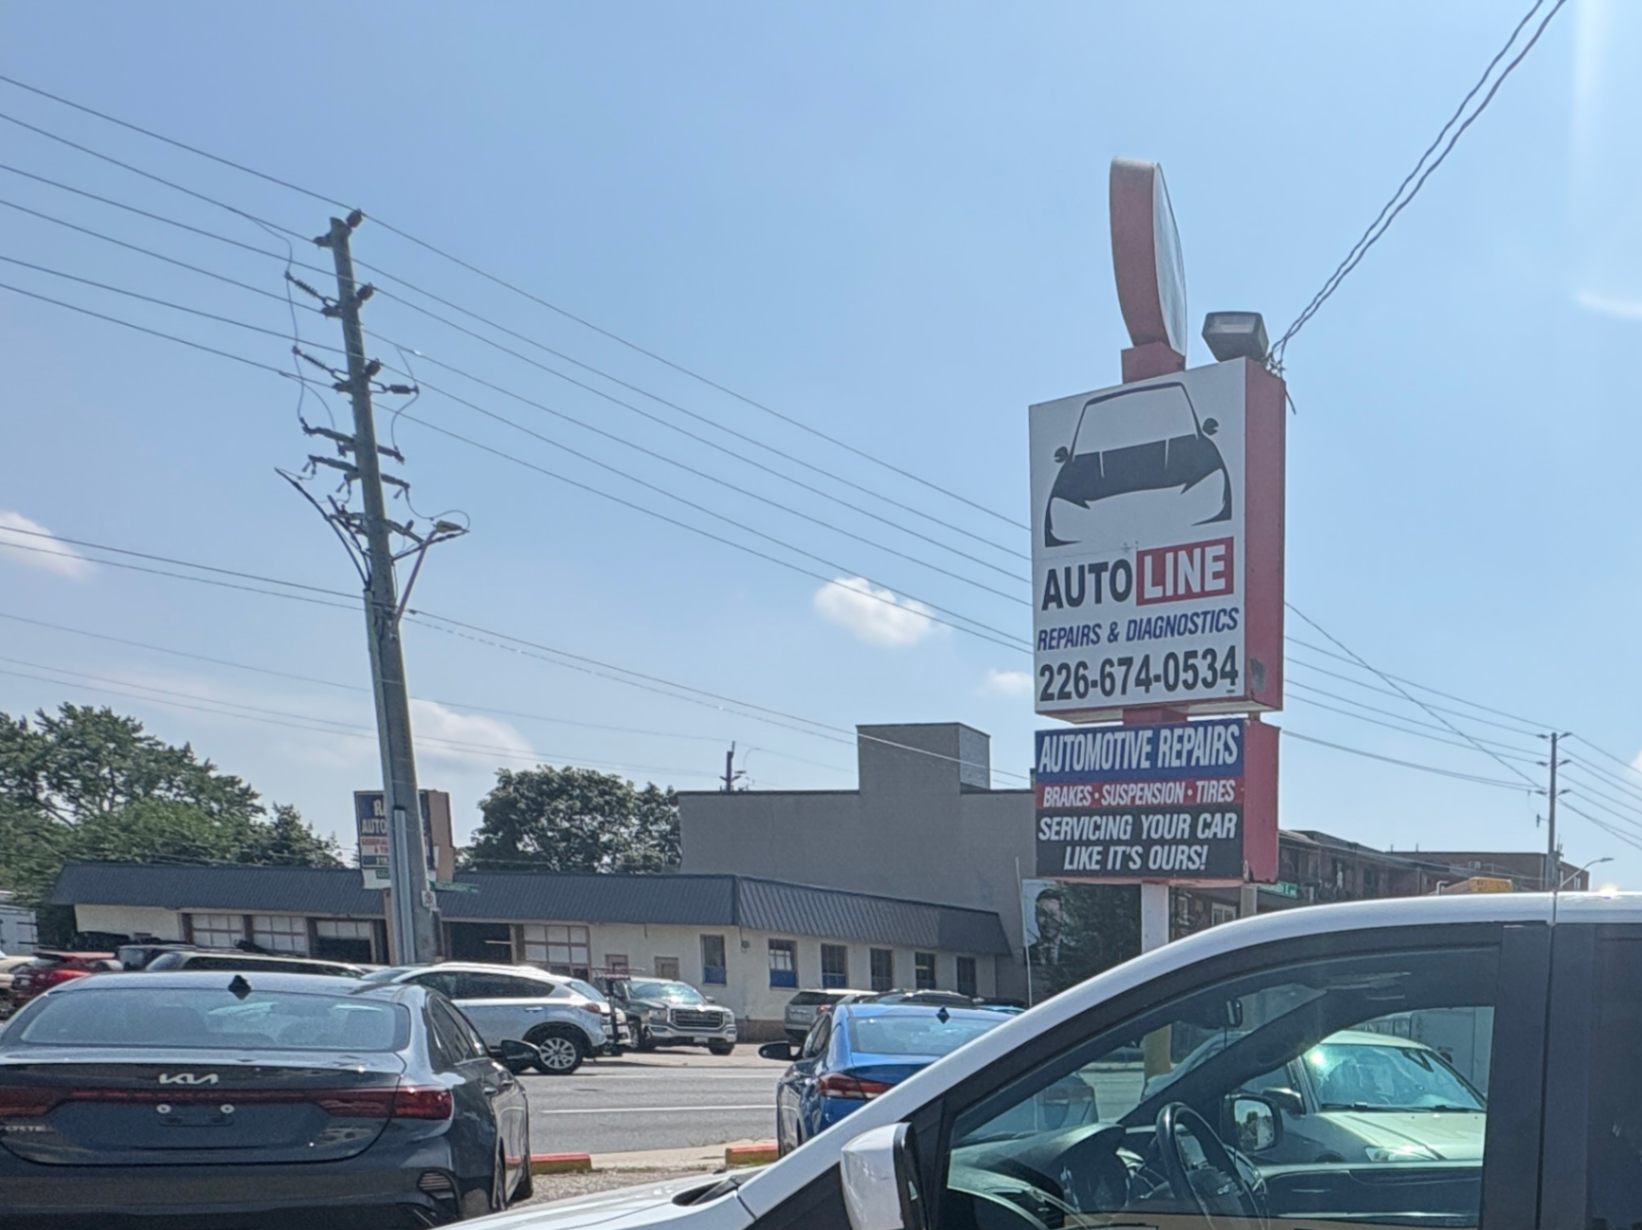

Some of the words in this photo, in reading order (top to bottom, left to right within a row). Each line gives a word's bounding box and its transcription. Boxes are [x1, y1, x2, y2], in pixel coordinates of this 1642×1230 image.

[1037, 623, 1102, 651] REPAIRS
[1107, 620, 1120, 644] &
[1126, 607, 1240, 642] DIAGNOSTICS
[1039, 645, 1239, 701] 226-674-0534
[1038, 730, 1153, 774] AUTOMOTIVE
[1157, 724, 1240, 769] REPAIRS
[1042, 785, 1092, 808] BRAKES
[1101, 781, 1186, 806] SUSPENSION
[1195, 779, 1236, 804] TIRES
[1038, 814, 1134, 841] SERVICING
[1140, 813, 1191, 840] YOUR
[1196, 812, 1238, 839] CAR
[1064, 845, 1104, 871] LIKE
[1107, 846, 1144, 871] IT'S
[1148, 844, 1209, 871] OURS!
[159, 1073, 219, 1085] KIA
